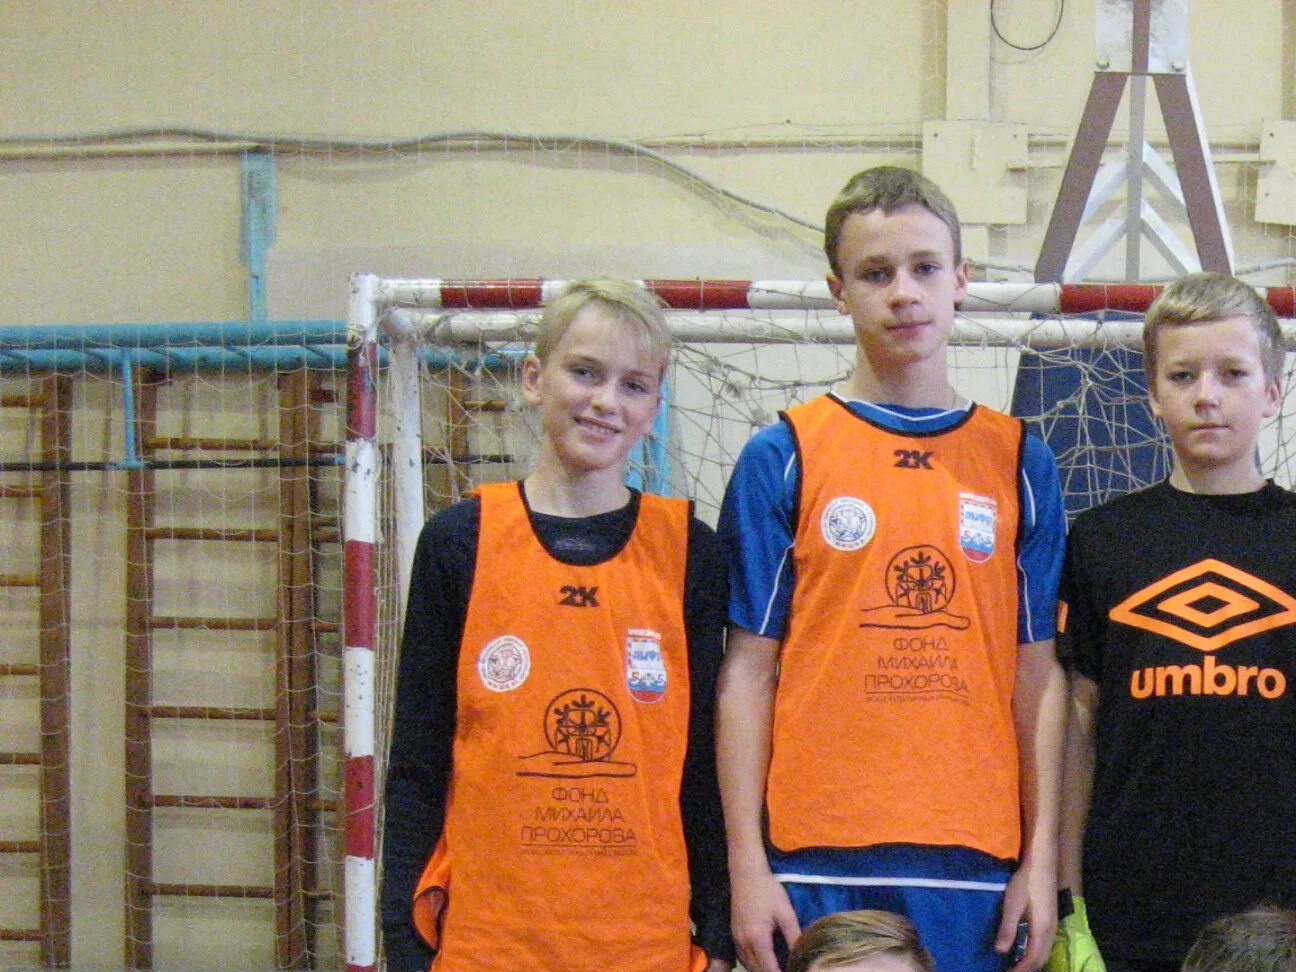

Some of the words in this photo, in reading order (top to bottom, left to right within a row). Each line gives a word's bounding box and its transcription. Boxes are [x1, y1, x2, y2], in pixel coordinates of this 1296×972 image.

[893, 636, 949, 652] ФОНД
[865, 673, 970, 693] ПРОХОРОВА
[1130, 655, 1287, 699] umbro
[551, 787, 609, 803] ФОНД
[534, 806, 626, 823] МИХАИЛА
[520, 826, 637, 843] ПРОХОРОВА
